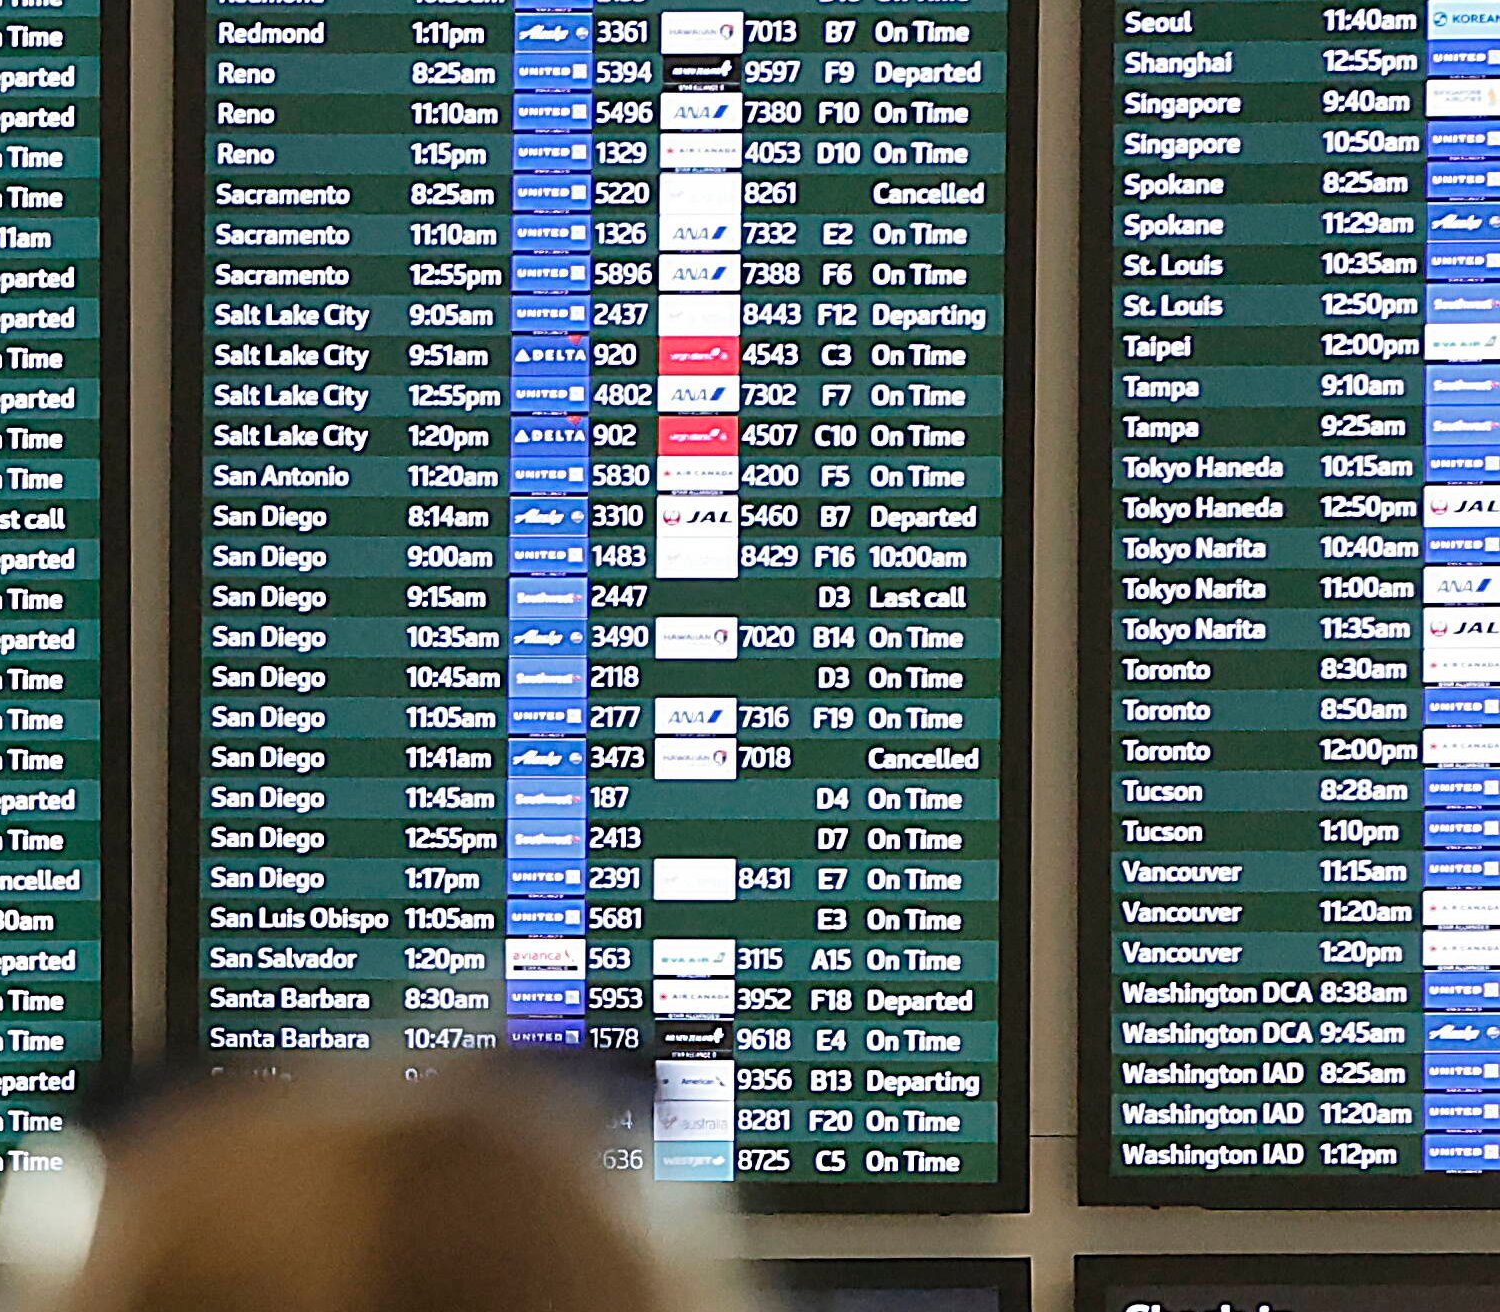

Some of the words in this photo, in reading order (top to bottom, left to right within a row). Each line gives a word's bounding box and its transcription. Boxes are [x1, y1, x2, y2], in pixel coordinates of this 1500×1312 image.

[1124, 10, 1193, 34] Seoul
[1323, 8, 1418, 32] 11:40am
[212, 504, 257, 527] San
[261, 504, 327, 532] Diego
[408, 505, 489, 528] 8:14am
[592, 504, 644, 527] 3310
[686, 511, 732, 524] JAL
[740, 504, 799, 527] 5460
[820, 505, 851, 528] B7
[870, 505, 977, 533] Departed
[1122, 496, 1192, 524] Tokyo
[1195, 495, 1284, 519] Haneda
[1320, 495, 1418, 522] 12:50pm
[1454, 500, 1496, 513] JAL
[1122, 1143, 1258, 1170] Washington
[1262, 1142, 1305, 1165] IAD
[1319, 1142, 1397, 1170] 1:12pm
